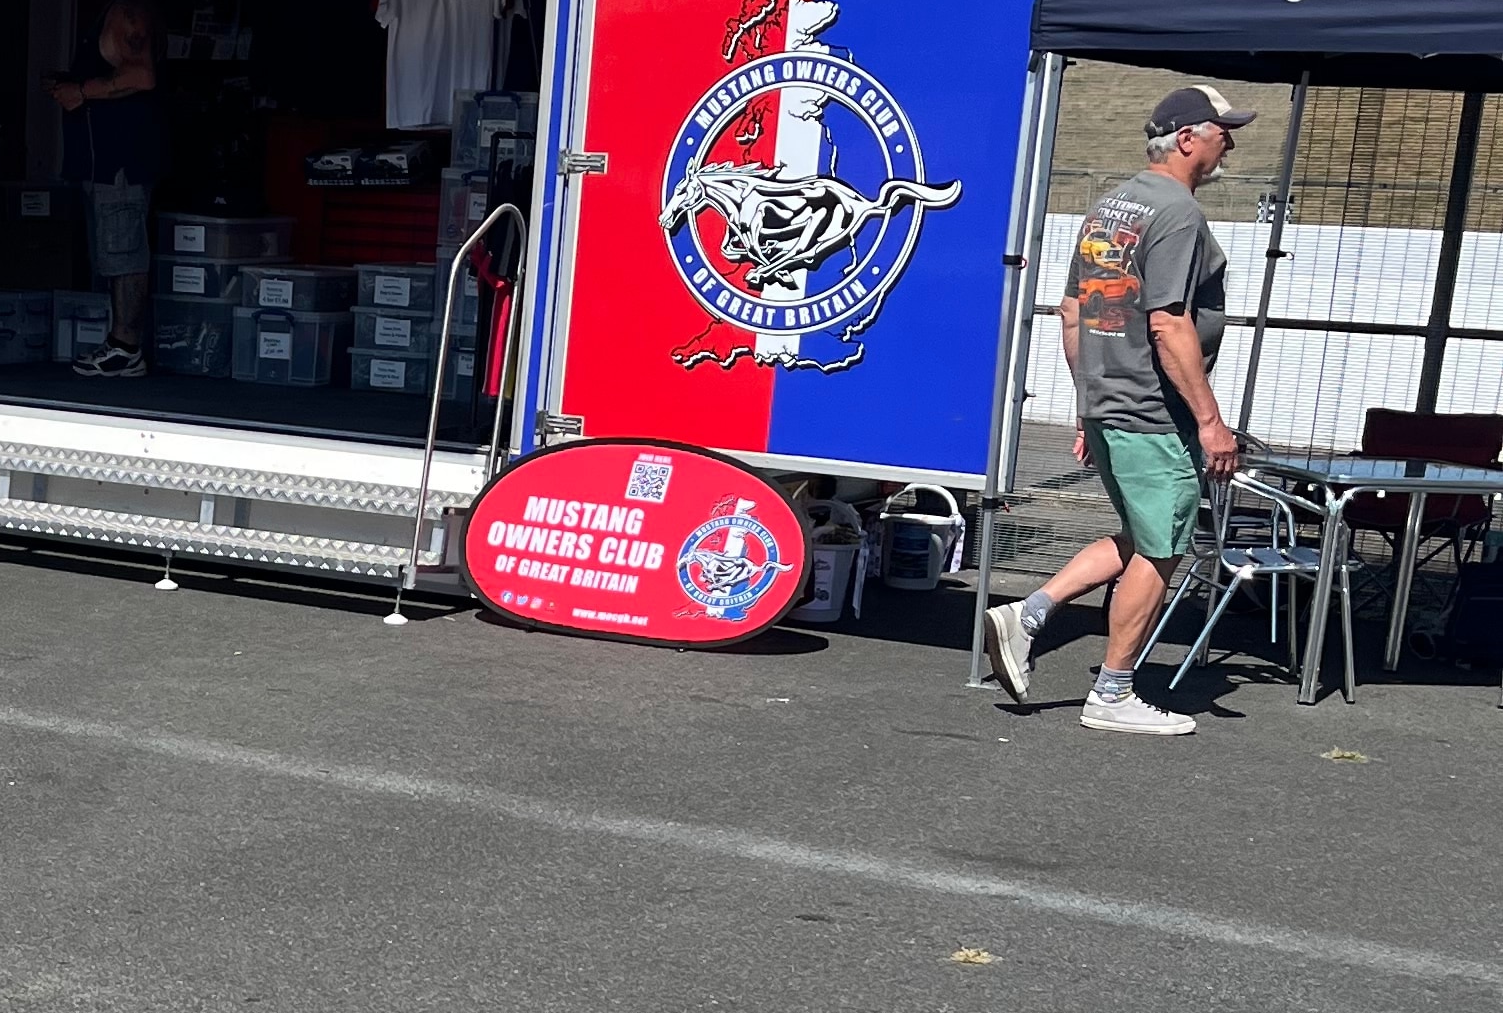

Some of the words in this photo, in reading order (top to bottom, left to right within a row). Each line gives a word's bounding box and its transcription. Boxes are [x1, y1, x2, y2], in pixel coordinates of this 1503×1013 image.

[694, 65, 776, 130] MUSTANG
[782, 61, 861, 95] OWNERS
[860, 88, 901, 138] CLUB
[692, 267, 716, 293] OF
[715, 291, 776, 326] GREAT
[785, 280, 868, 327] BRITAIN
[523, 496, 645, 536] MUSTANG
[487, 521, 594, 560] OWNERS
[598, 537, 665, 570] CLUB
[495, 555, 517, 573] OF
[517, 559, 570, 584] GREAT
[570, 568, 639, 594] BRITAIN
